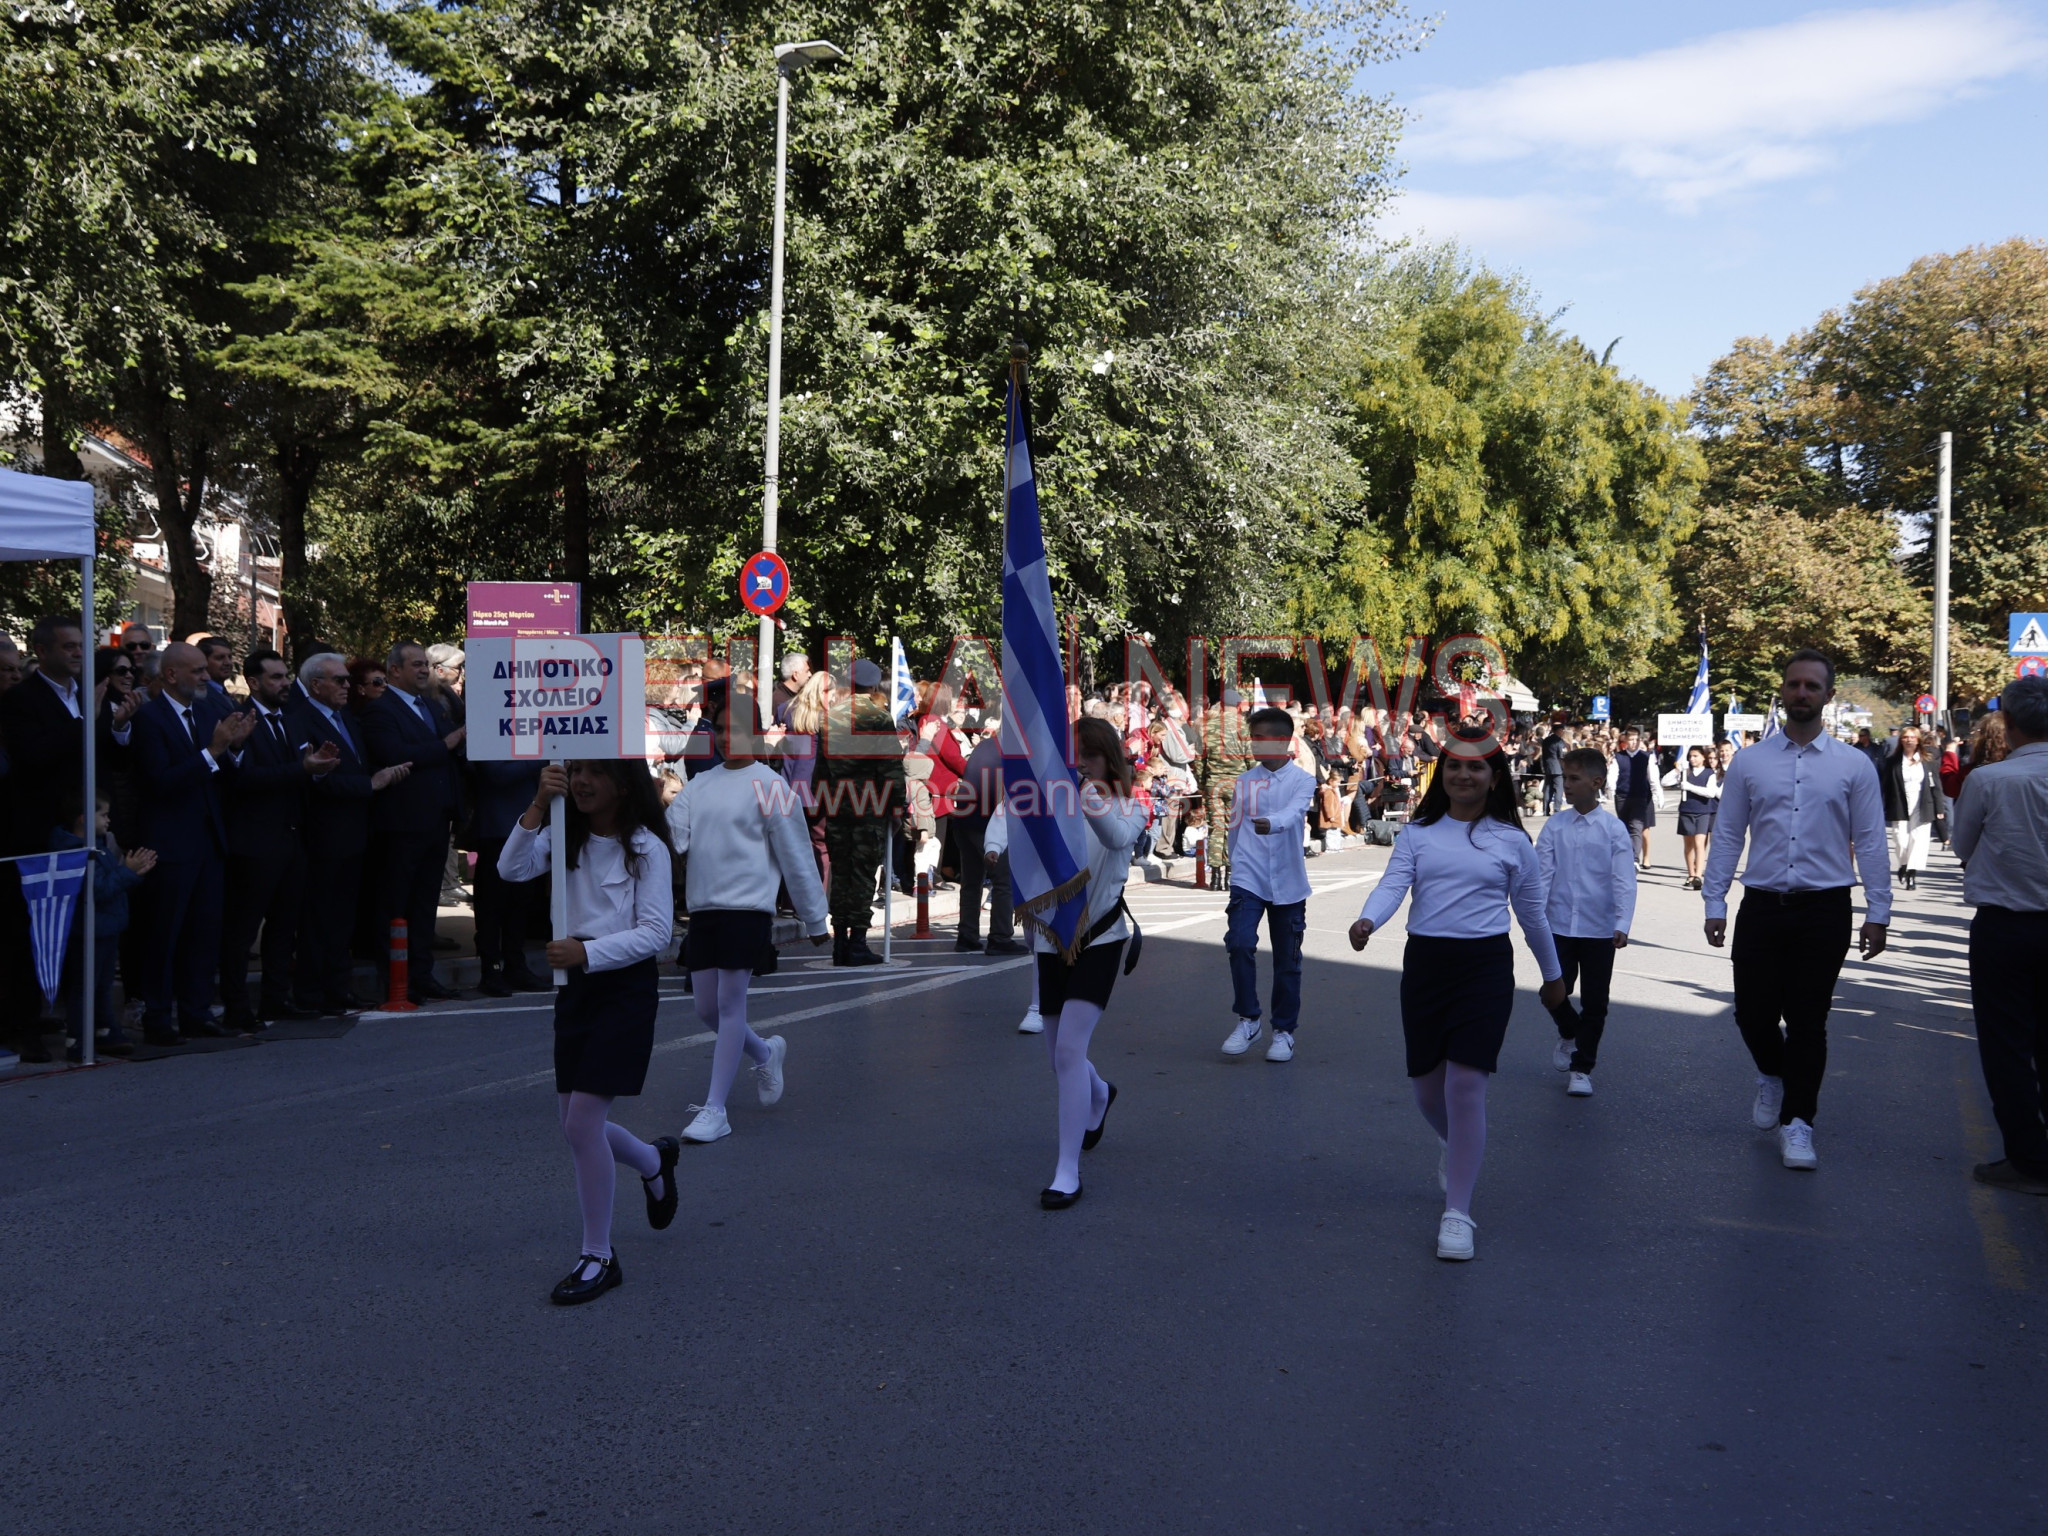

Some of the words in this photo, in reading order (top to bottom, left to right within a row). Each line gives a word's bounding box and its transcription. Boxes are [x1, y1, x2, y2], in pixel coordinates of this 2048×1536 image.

[473, 611, 492, 619] Πάρκο
[509, 611, 535, 619] Μαρτίου
[492, 657, 613, 680] ΔΗΜΟΤΙΚΟ
[503, 687, 602, 708] ΣΧΟΛΕΙΟ
[499, 716, 609, 736] ΚΕΡΑΣΙΑΣ
